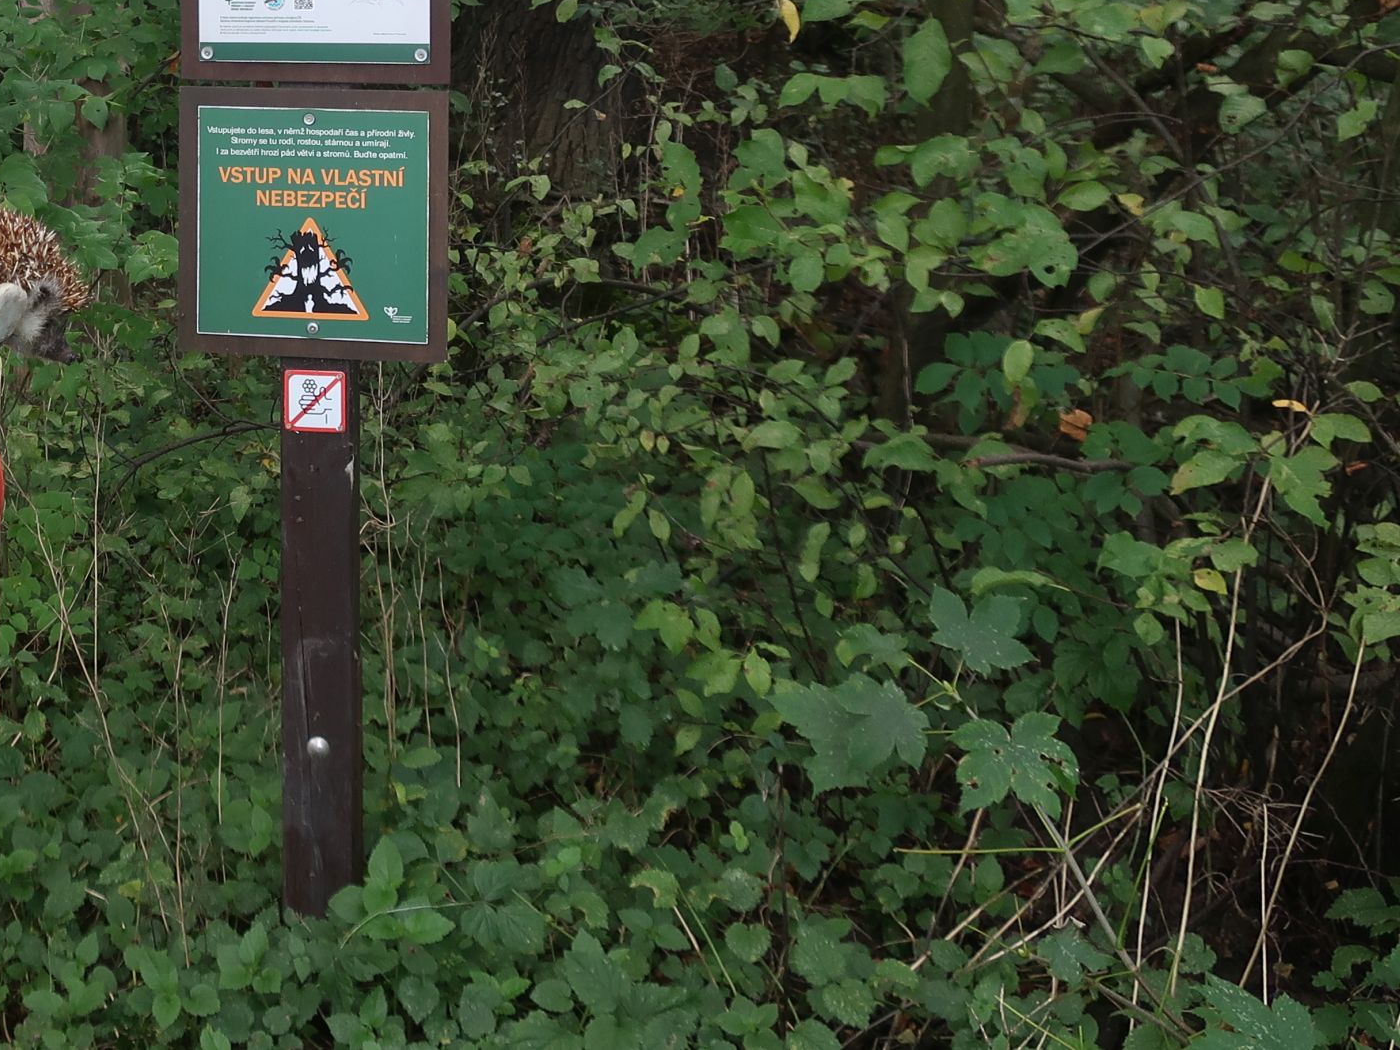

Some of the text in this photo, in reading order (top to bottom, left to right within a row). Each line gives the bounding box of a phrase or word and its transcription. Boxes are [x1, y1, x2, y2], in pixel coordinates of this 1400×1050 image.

[207, 126, 245, 135] Vstupujete
[258, 127, 276, 135] lesa,
[306, 128, 344, 137] hospodaří
[366, 129, 396, 138] přírodní
[397, 130, 416, 139] živly.
[231, 136, 257, 146] Stromy
[269, 137, 277, 145] tu
[297, 138, 323, 146] rostou,
[362, 139, 391, 148] umírají.
[230, 148, 259, 156] bezvětří
[260, 148, 279, 156] hrozí
[280, 149, 295, 158] pád
[322, 150, 352, 158] stromů.
[378, 151, 408, 160] opatrní.
[218, 166, 405, 187] VSTUP NA VLASTNÍ
[256, 187, 367, 209] NEBEZPEČÍ
